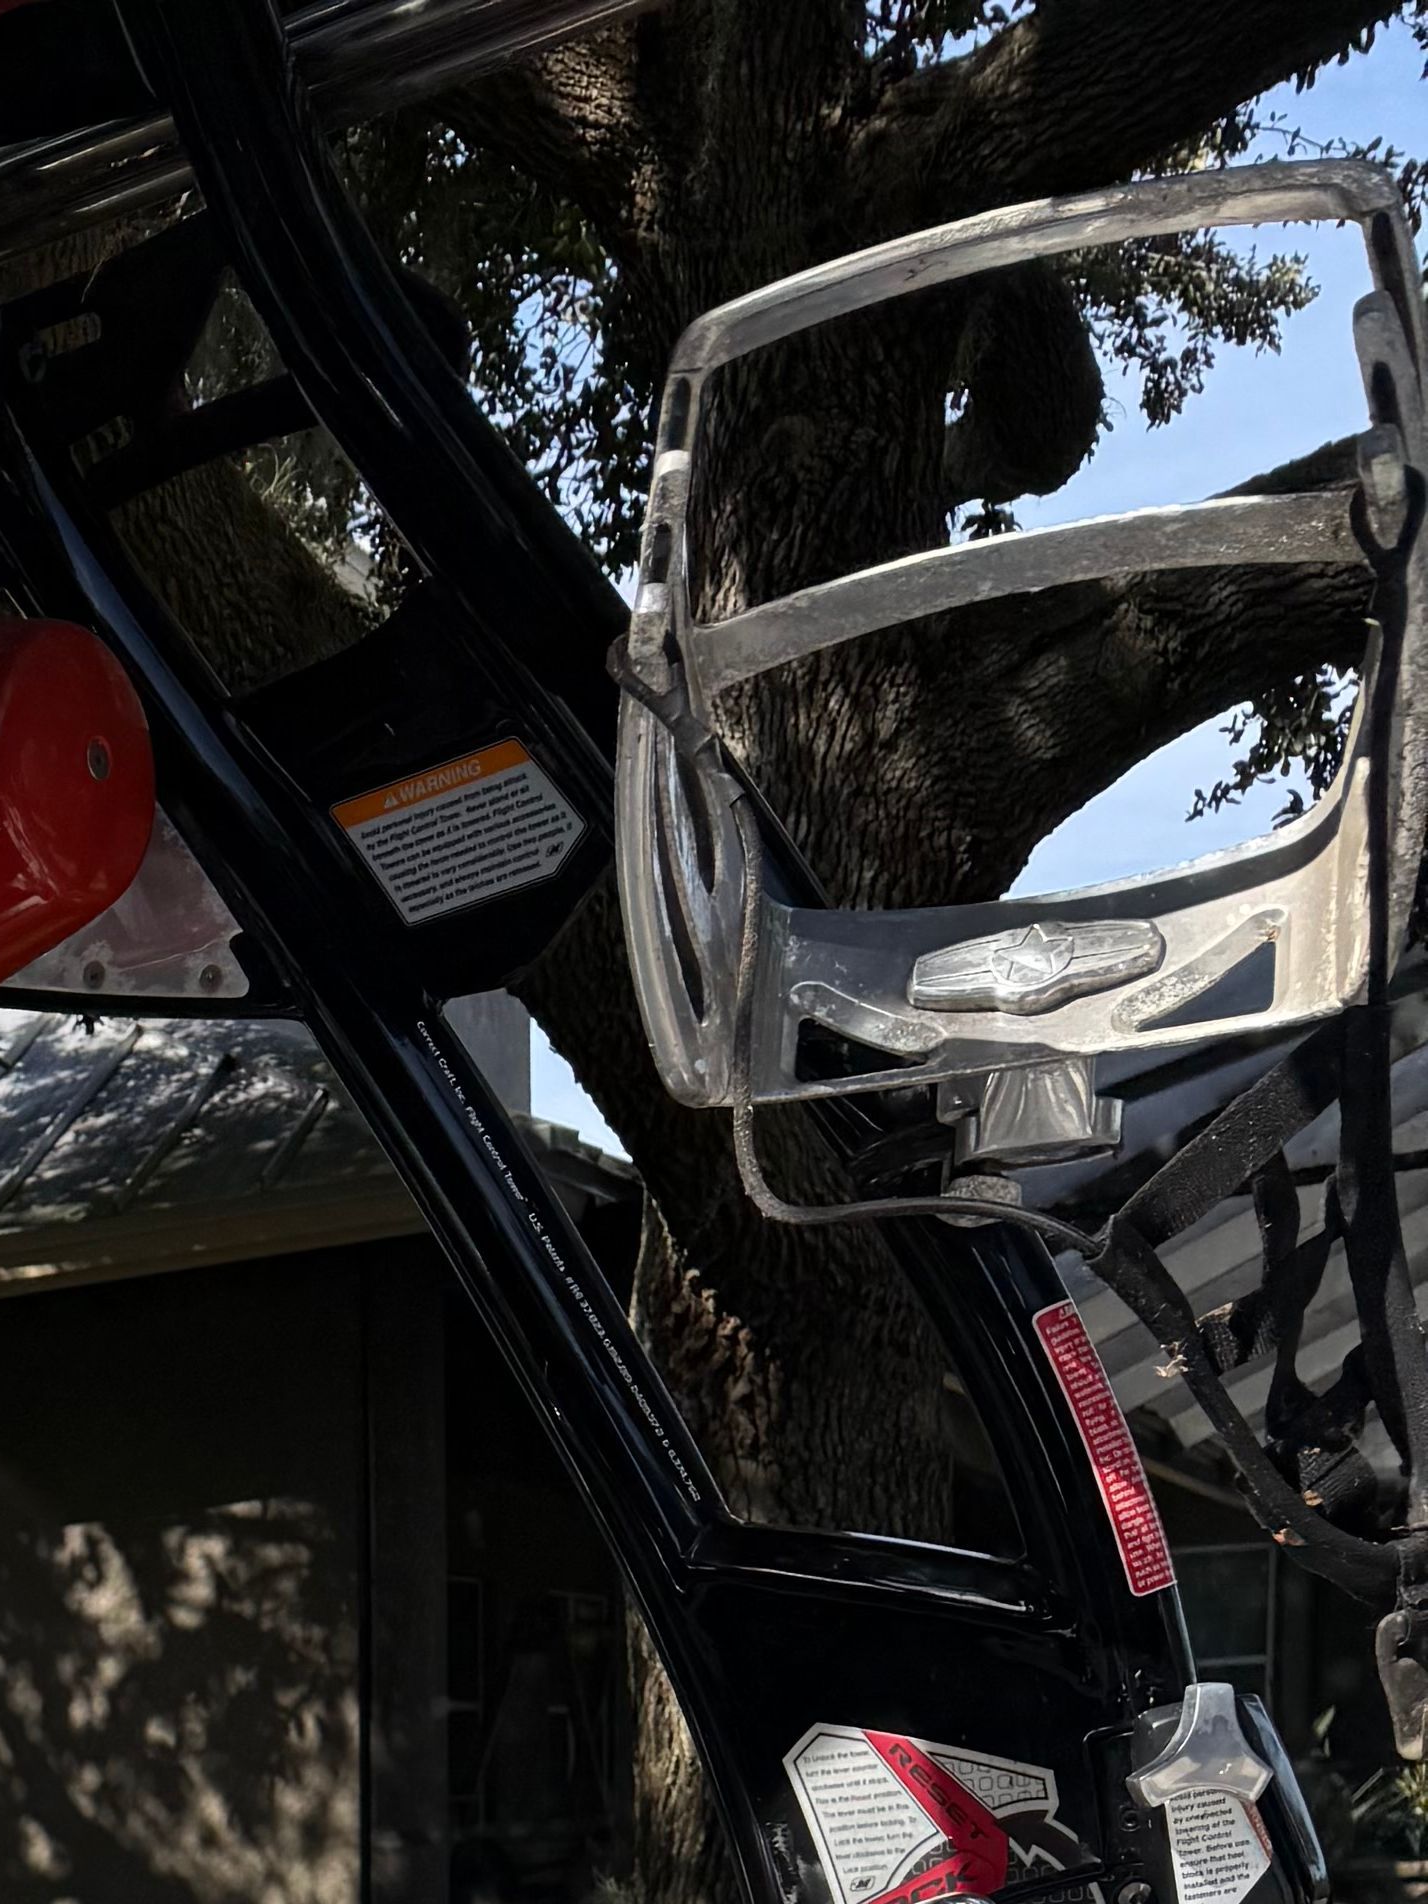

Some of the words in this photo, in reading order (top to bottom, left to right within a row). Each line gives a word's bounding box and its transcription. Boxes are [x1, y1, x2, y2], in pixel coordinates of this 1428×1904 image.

[399, 758, 481, 801] WARNING
[515, 793, 543, 808] Control
[411, 818, 438, 834] Control
[888, 1743, 991, 1840] RESET
[1197, 1798, 1226, 1808] caused
[1186, 1809, 1232, 1822] unexpected
[1212, 1821, 1220, 1829] of
[1177, 1834, 1199, 1846] Flight
[1202, 1831, 1232, 1842] Control
[1210, 1853, 1225, 1863] that
[1206, 1867, 1213, 1875] is
[1215, 1862, 1249, 1875] properly
[1220, 1876, 1235, 1885] and
[1237, 1873, 1250, 1881] the
